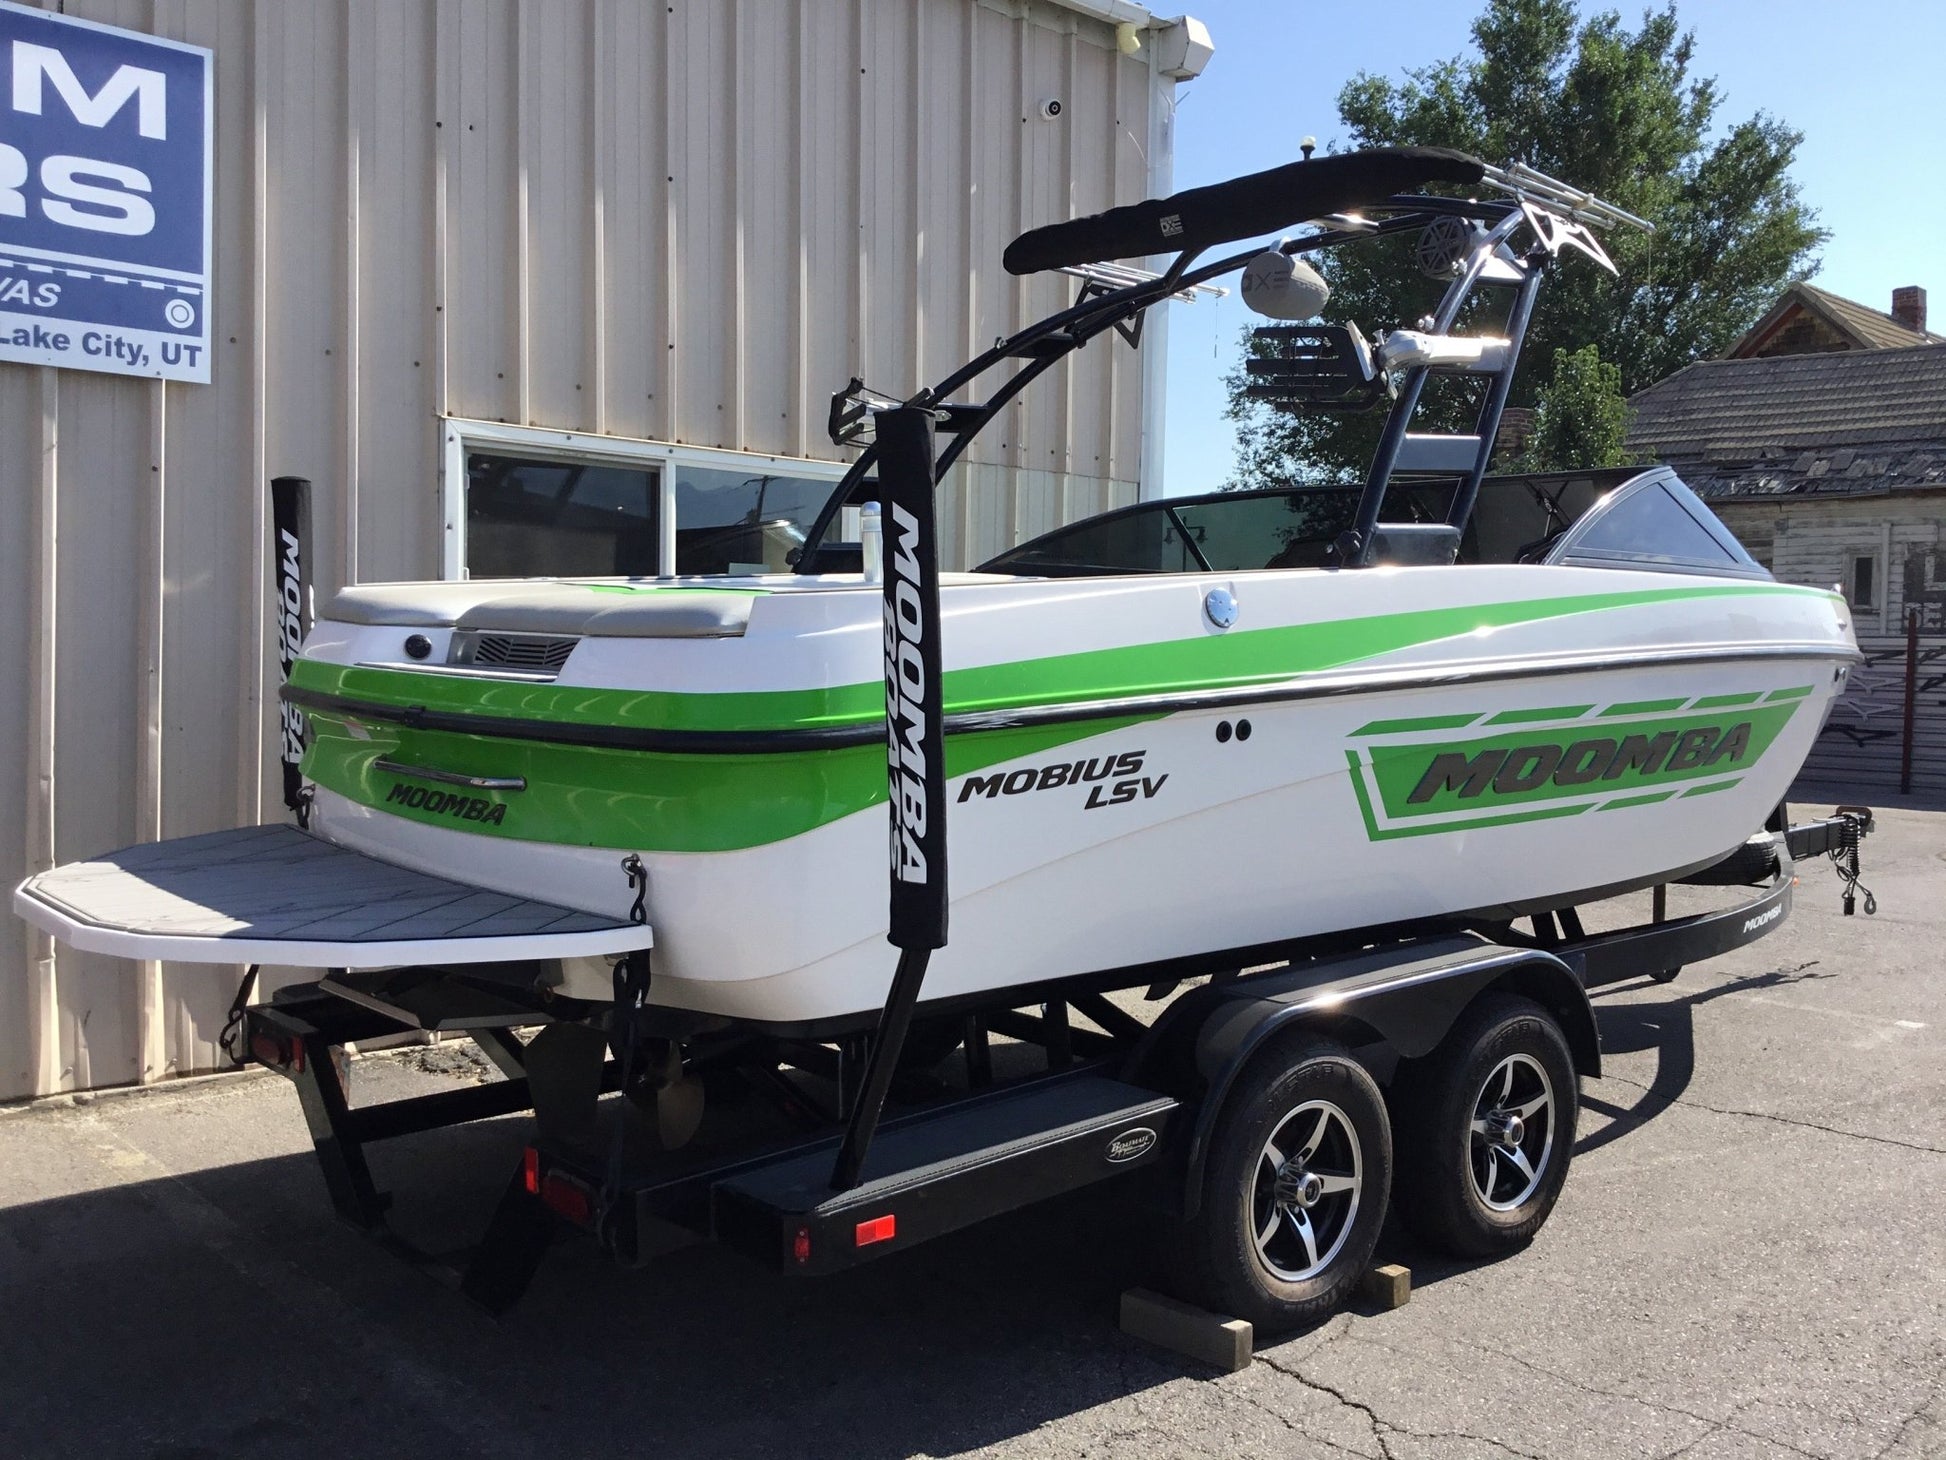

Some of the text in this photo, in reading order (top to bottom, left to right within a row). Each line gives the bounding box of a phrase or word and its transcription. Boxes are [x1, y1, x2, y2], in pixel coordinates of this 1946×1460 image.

[0, 142, 156, 236] S
[81, 331, 149, 366] City,
[161, 341, 202, 368] UT
[281, 527, 304, 764] MOOBA
[892, 501, 928, 884] MOOMBA
[956, 750, 1147, 803] MOBIUS
[1084, 773, 1169, 810] LSV
[1406, 722, 1752, 804] MOOMBA
[385, 783, 508, 826] MOOMBA
